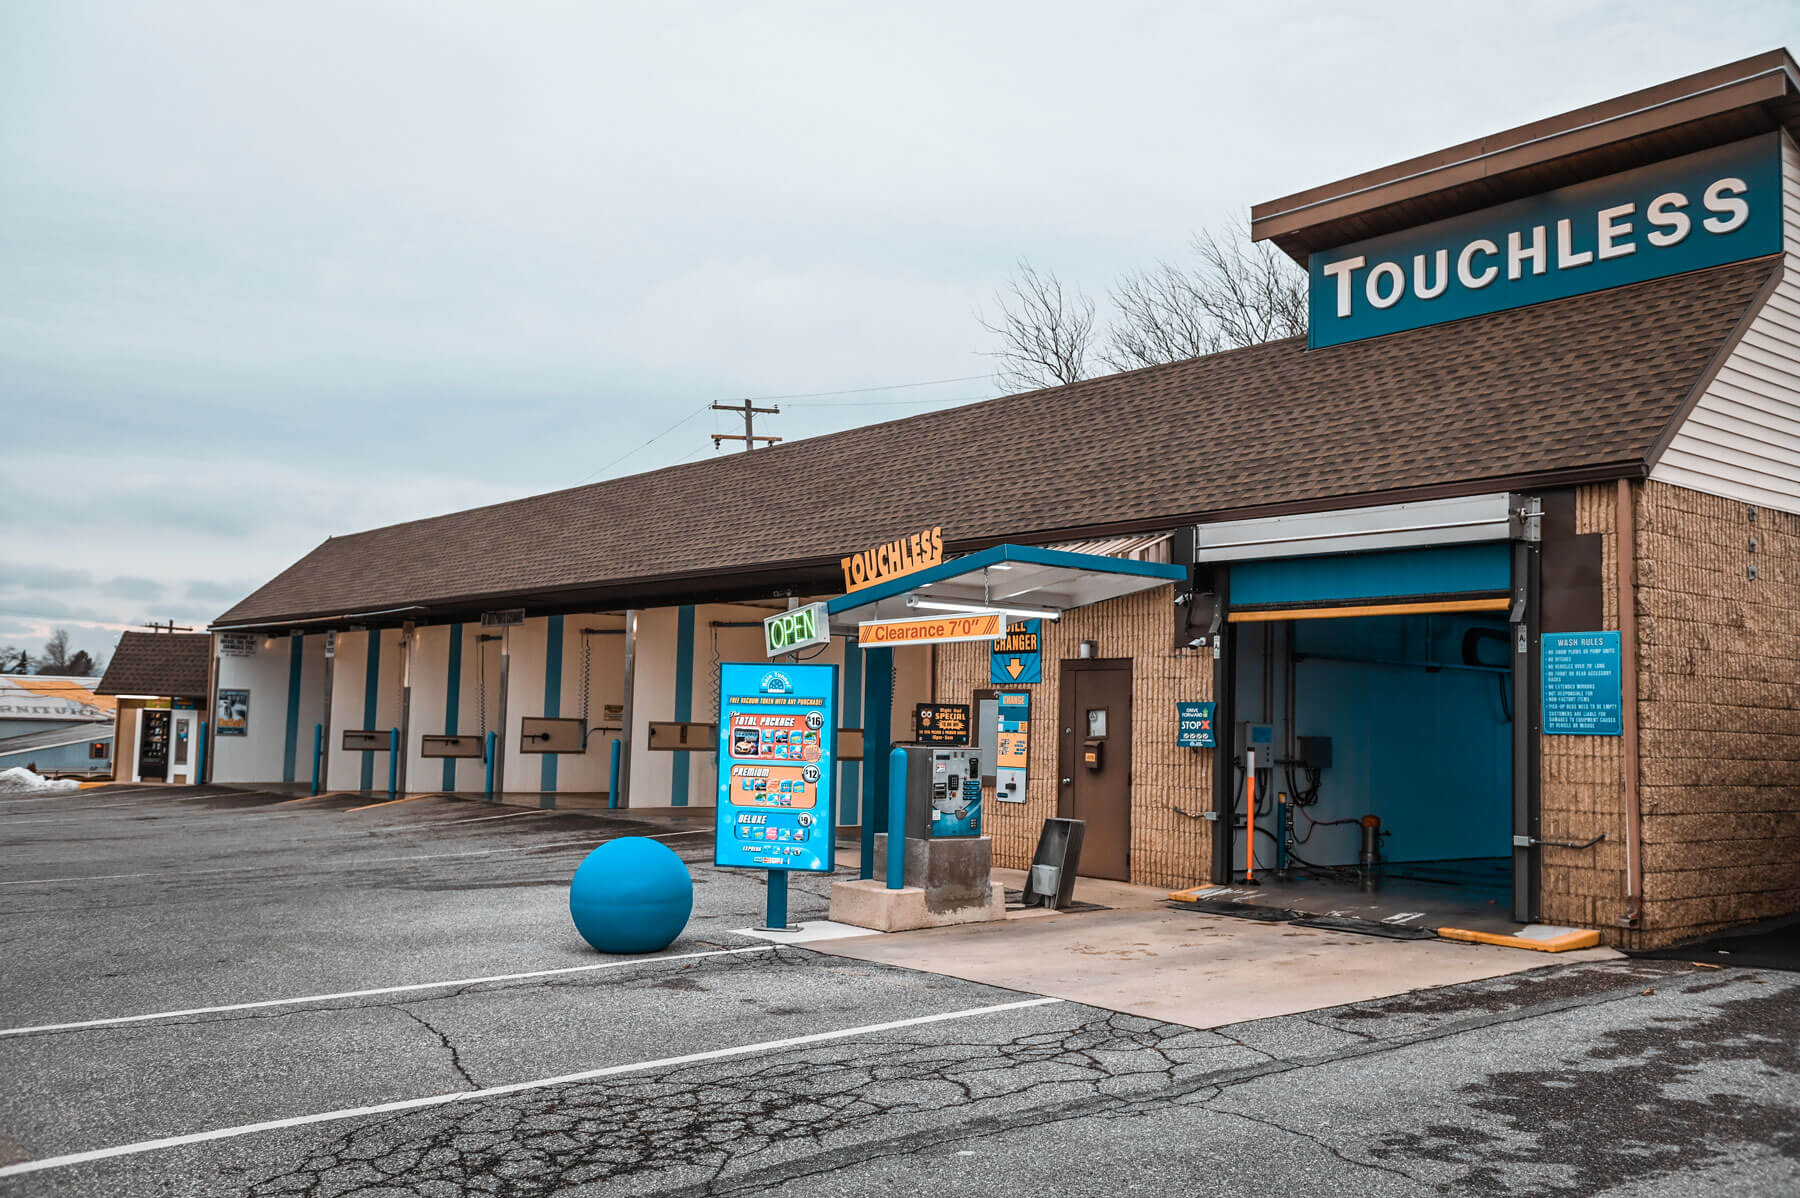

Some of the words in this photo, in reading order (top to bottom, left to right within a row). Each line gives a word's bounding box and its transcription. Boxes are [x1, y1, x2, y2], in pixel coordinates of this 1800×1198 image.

[1323, 177, 1750, 318] TOUCHLESS
[841, 526, 943, 592] TOUCHLESS
[769, 608, 817, 650] OPEN
[875, 624, 945, 641] Clearance
[993, 633, 1037, 652] CHANGER
[1557, 639, 1578, 647] WASH
[1581, 637, 1604, 646] RULES
[806, 716, 821, 726] $16
[935, 712, 966, 720] SPECIAL
[734, 716, 757, 726] TOTAL
[759, 717, 795, 727] PACKAGE
[1181, 720, 1201, 730] STOP
[732, 767, 770, 777] PREMIUM
[805, 769, 817, 779] $12
[738, 814, 767, 824] DELUXE
[801, 816, 809, 825] $9
